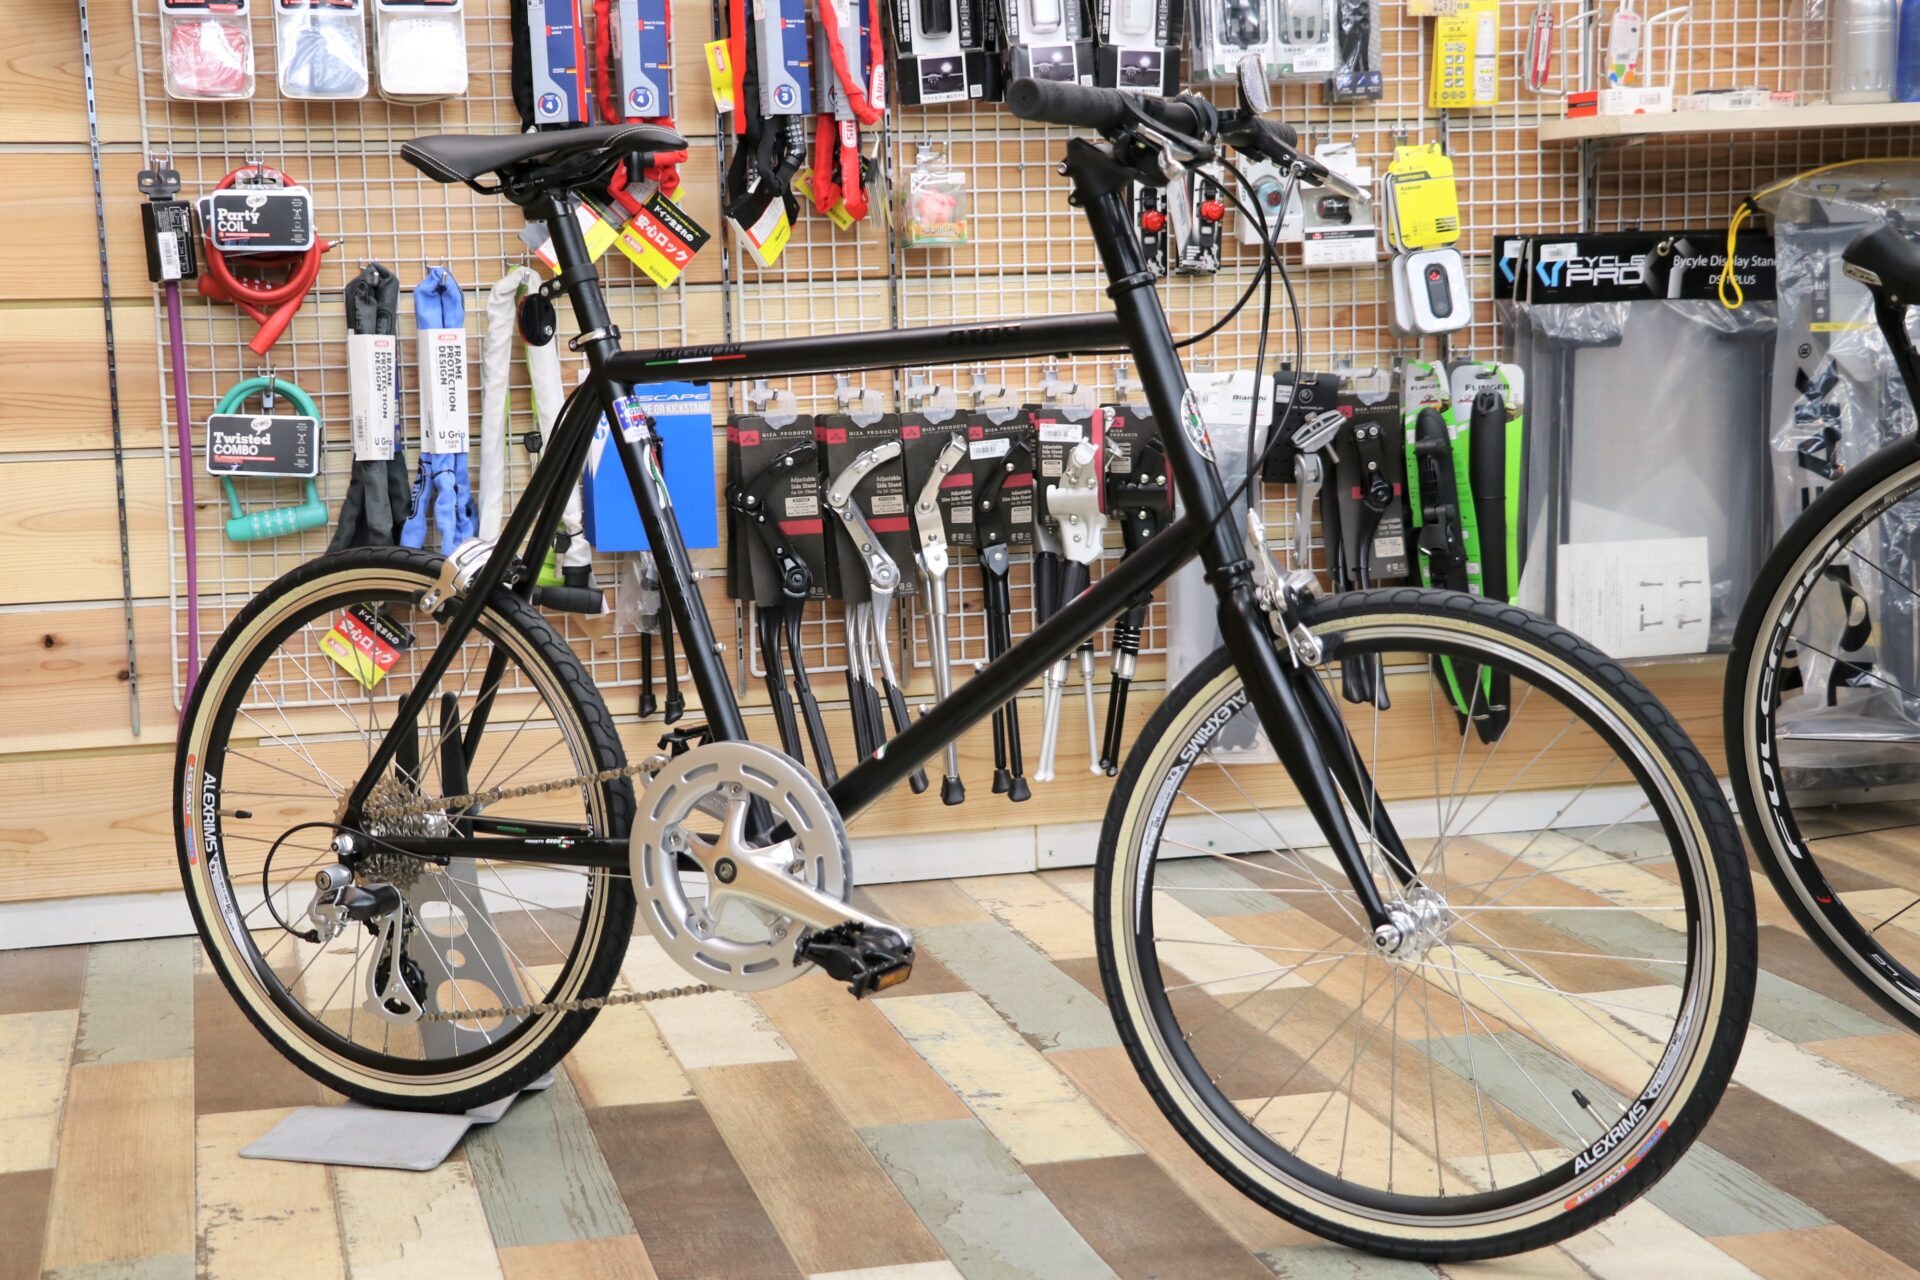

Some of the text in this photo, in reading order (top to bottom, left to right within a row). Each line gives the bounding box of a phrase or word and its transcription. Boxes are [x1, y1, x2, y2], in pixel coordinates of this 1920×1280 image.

[217, 208, 260, 225] Party
[217, 221, 249, 232] COIL
[634, 213, 689, 262] 安心ロック
[1566, 254, 1646, 268] CYCLE
[1674, 254, 1708, 269] Bycyle
[1710, 255, 1750, 268] Dislay
[1565, 267, 1645, 287] PRO
[374, 352, 382, 392] DESIGN
[438, 345, 447, 386] DESIGN
[454, 345, 462, 380] FRAME
[380, 352, 388, 419] PROTECTION
[447, 345, 456, 412] PROTECTION
[666, 402, 711, 413] KICKSTAND
[213, 432, 272, 445] Twisted
[374, 438, 380, 446] U
[439, 431, 446, 439] U
[213, 444, 259, 456] COMBO
[338, 618, 393, 664] 安心ロック
[1180, 689, 1246, 765] ALEXRIMS
[203, 771, 217, 853] ALEXRIMS
[1574, 1101, 1648, 1175] ALEXRIMS
